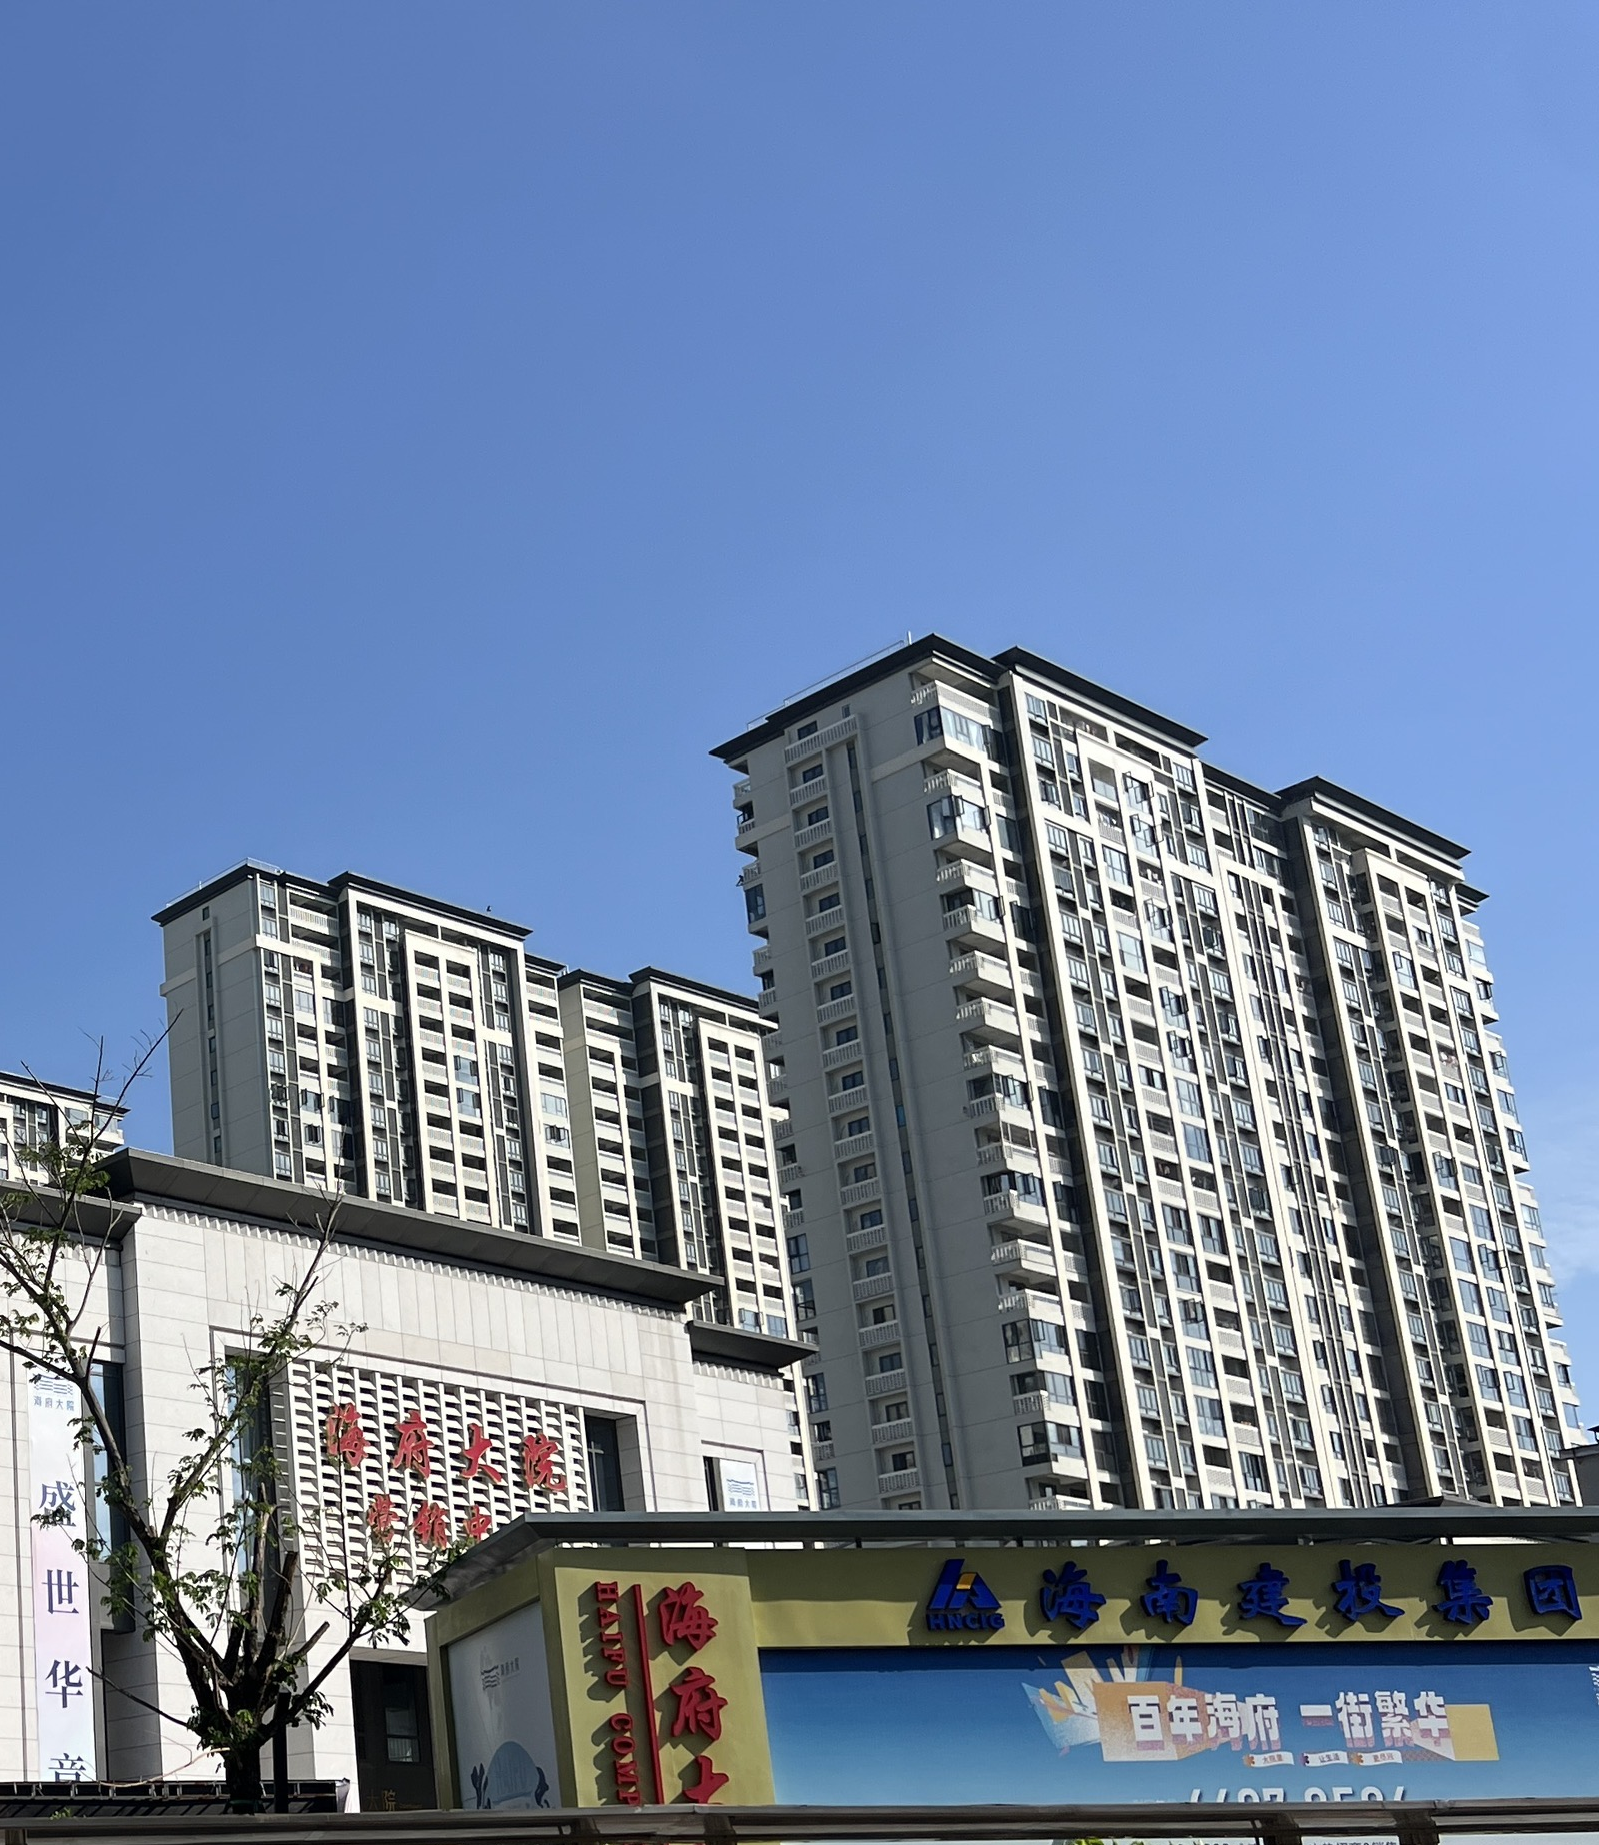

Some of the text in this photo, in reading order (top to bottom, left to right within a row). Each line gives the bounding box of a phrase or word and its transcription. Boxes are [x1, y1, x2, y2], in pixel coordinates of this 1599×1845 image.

[326, 1402, 567, 1492] 海府大院
[926, 1613, 1005, 1631] HNCIG
[1040, 1558, 1583, 1630] 海南建投集团
[595, 1581, 629, 1688] HAIFU
[1127, 1691, 1449, 1744] 百年海府 一街繁华
